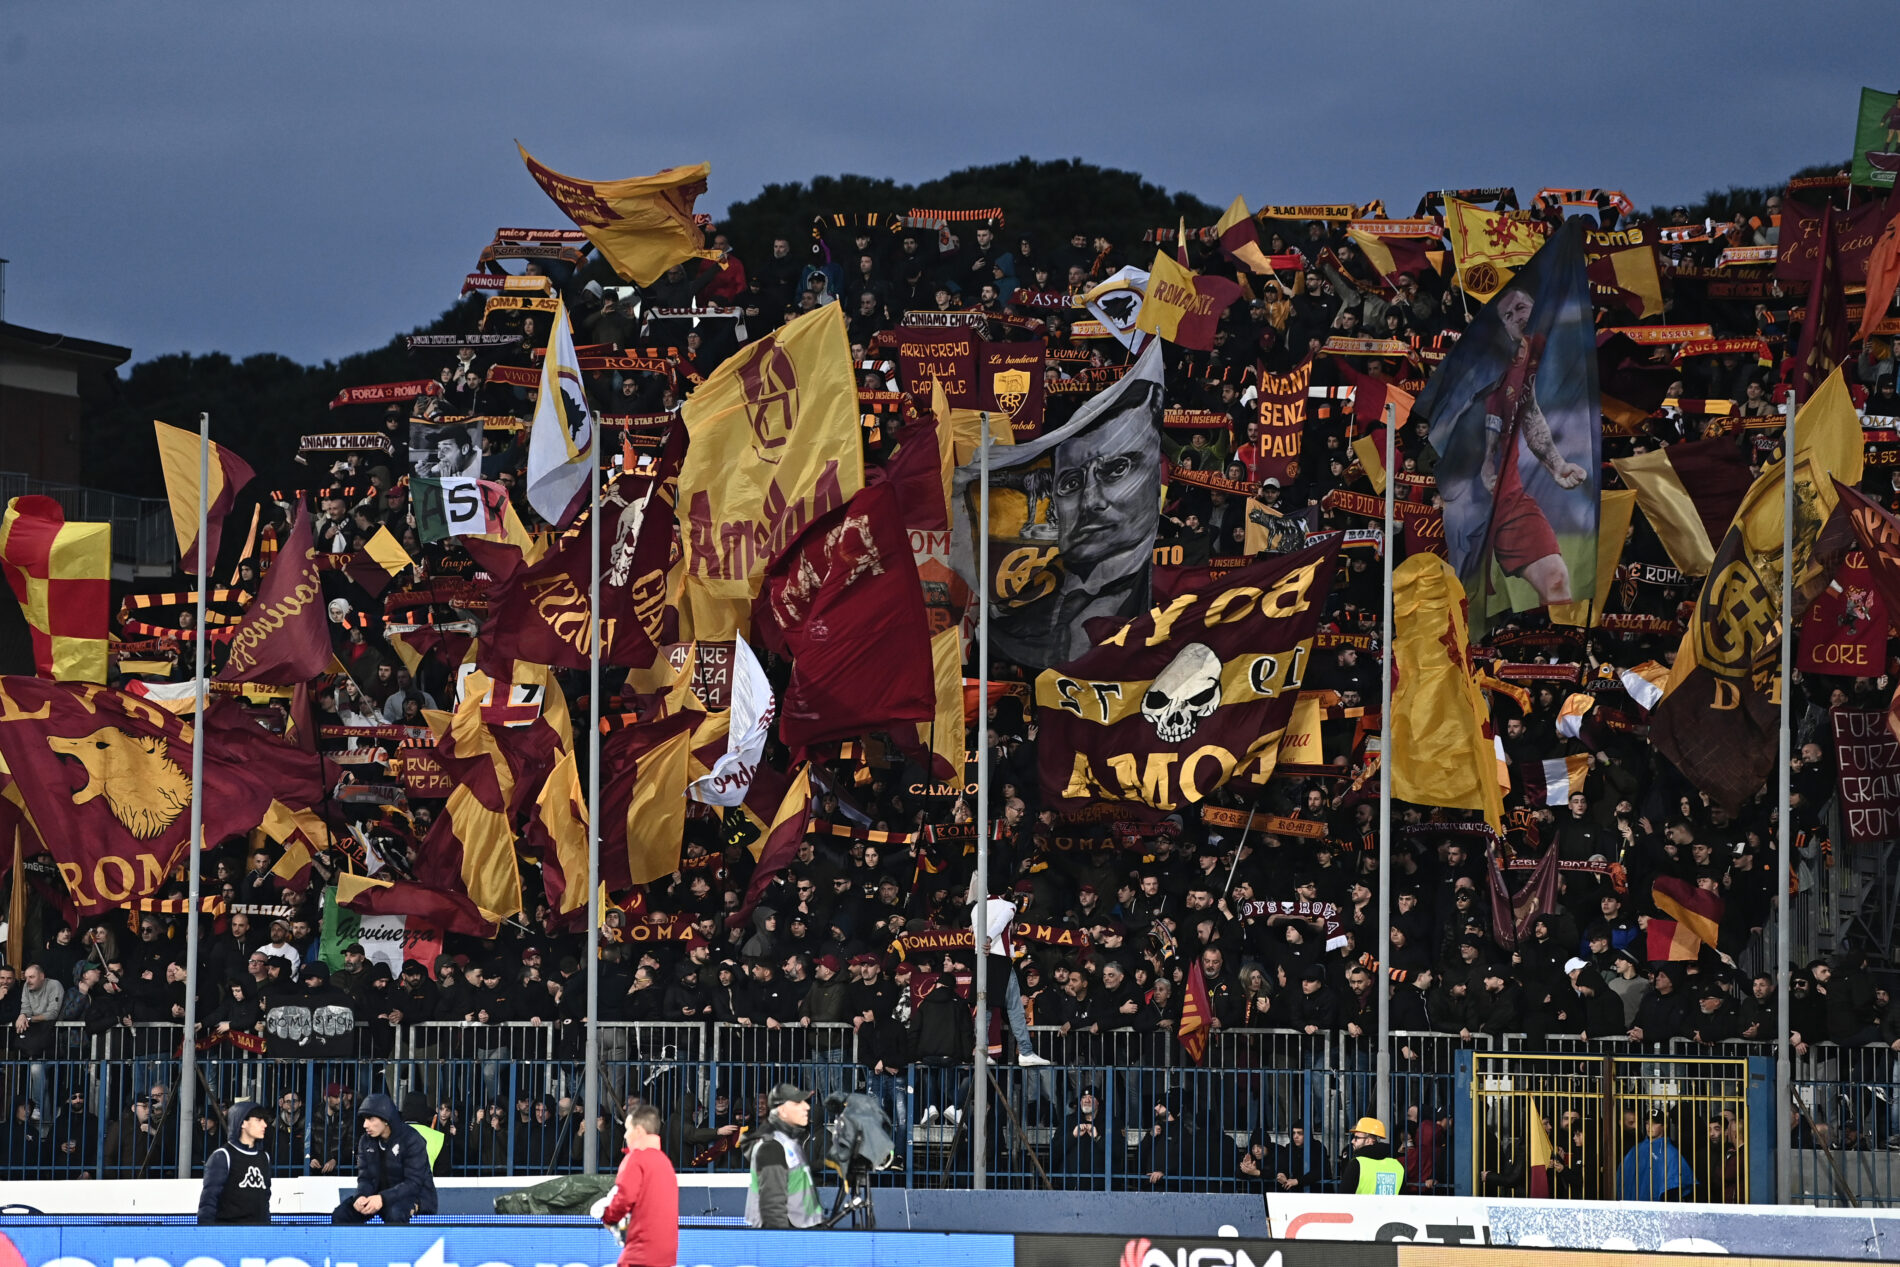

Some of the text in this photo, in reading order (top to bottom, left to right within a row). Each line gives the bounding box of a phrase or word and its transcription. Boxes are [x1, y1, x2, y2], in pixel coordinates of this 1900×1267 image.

[526, 229, 562, 241] grande
[901, 340, 970, 358] ARRIVEREMO
[605, 356, 666, 371] ROMA
[919, 361, 957, 377] DALLA
[351, 383, 422, 400] FORZA ROMA
[1259, 398, 1307, 427] SENZ
[300, 435, 338, 449] CINIAMO
[1405, 473, 1426, 483] STAR
[440, 556, 473, 571] Grazie
[1645, 567, 1686, 584] ROMA
[1812, 643, 1869, 665] CORE
[56, 840, 180, 907] ROM
[335, 916, 437, 950] Giovinezza
[612, 925, 694, 943] ROMA
[1017, 922, 1074, 945] OMA
[903, 934, 936, 951] ROMA
